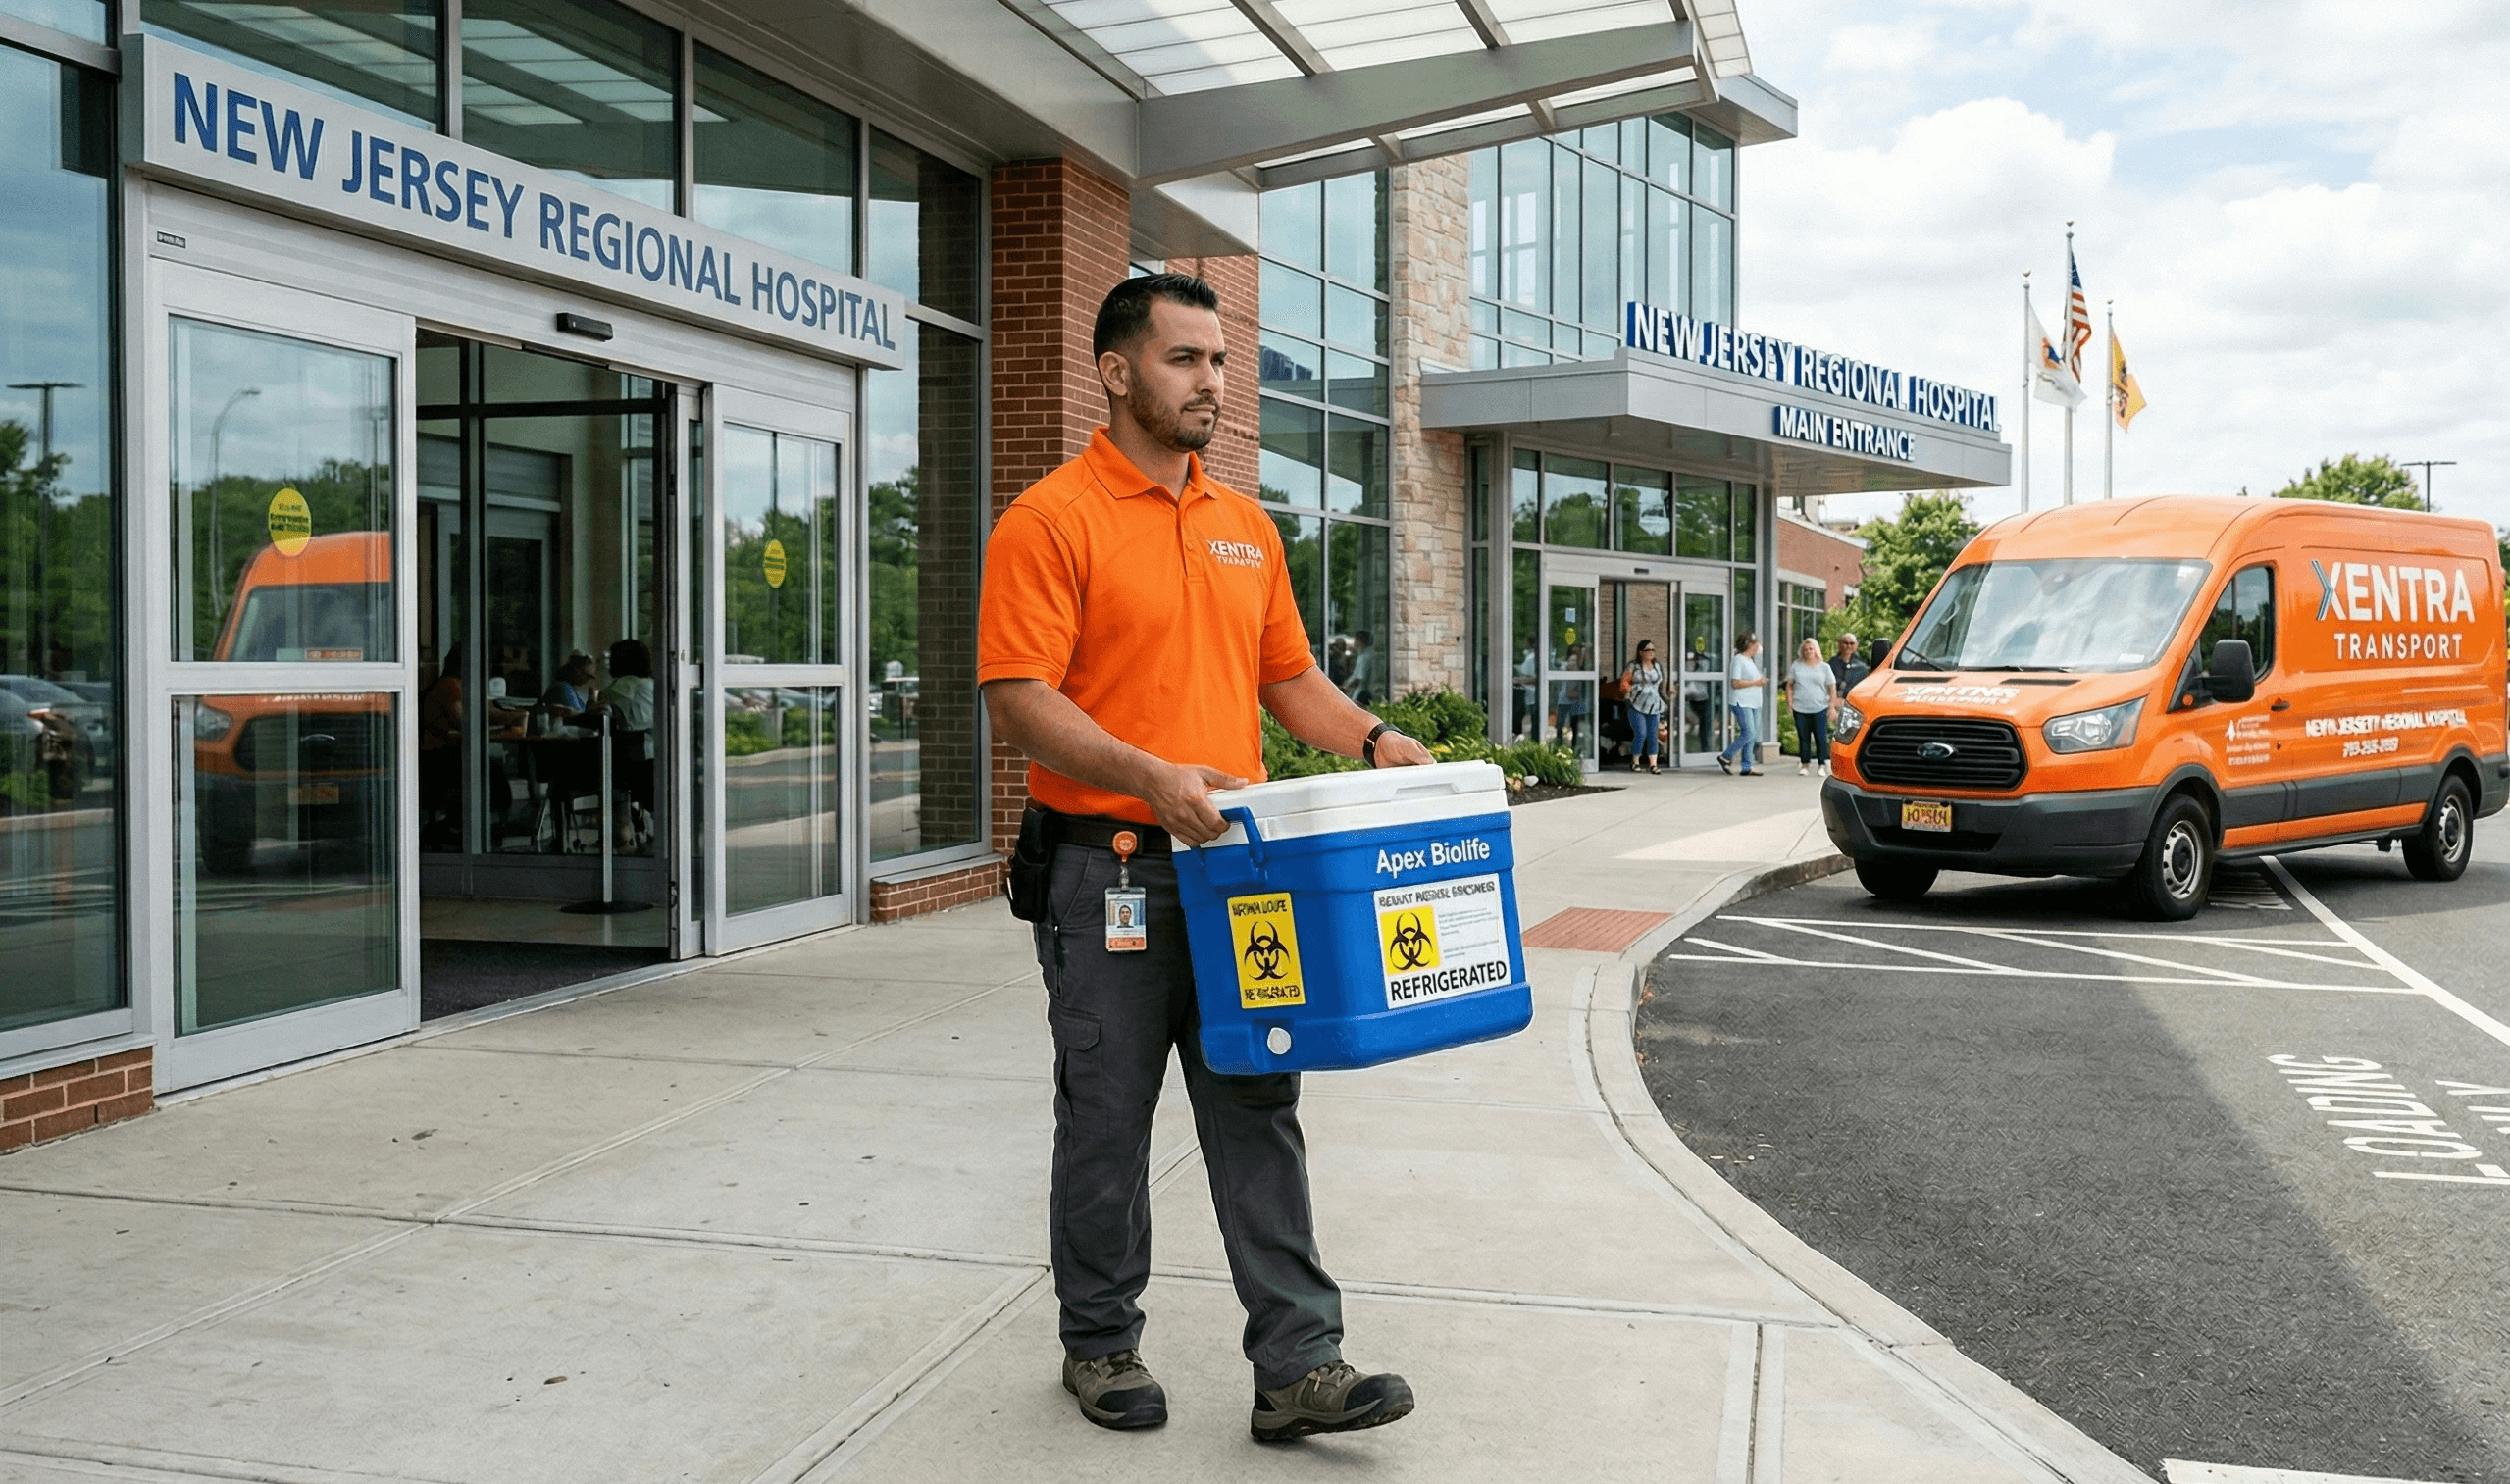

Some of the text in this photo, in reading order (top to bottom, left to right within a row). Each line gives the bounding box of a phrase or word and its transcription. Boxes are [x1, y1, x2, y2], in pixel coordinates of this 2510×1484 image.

[174, 72, 896, 351] NEW JERSEY REGIONAL HOSPITAL
[1628, 302, 2002, 432] NEW JERSEY REGIONAL HOSPITAL
[1773, 406, 1916, 461] MAIN ENTRANCE
[1206, 539, 1264, 560] XENTRA
[2311, 560, 2476, 623] XENTRA
[2333, 633, 2463, 660] TRANSPORT
[1377, 837, 1490, 879] Apex Biolife
[1390, 960, 1508, 1001] REFRIGERATED
[2267, 1053, 2510, 1185] LOADING
